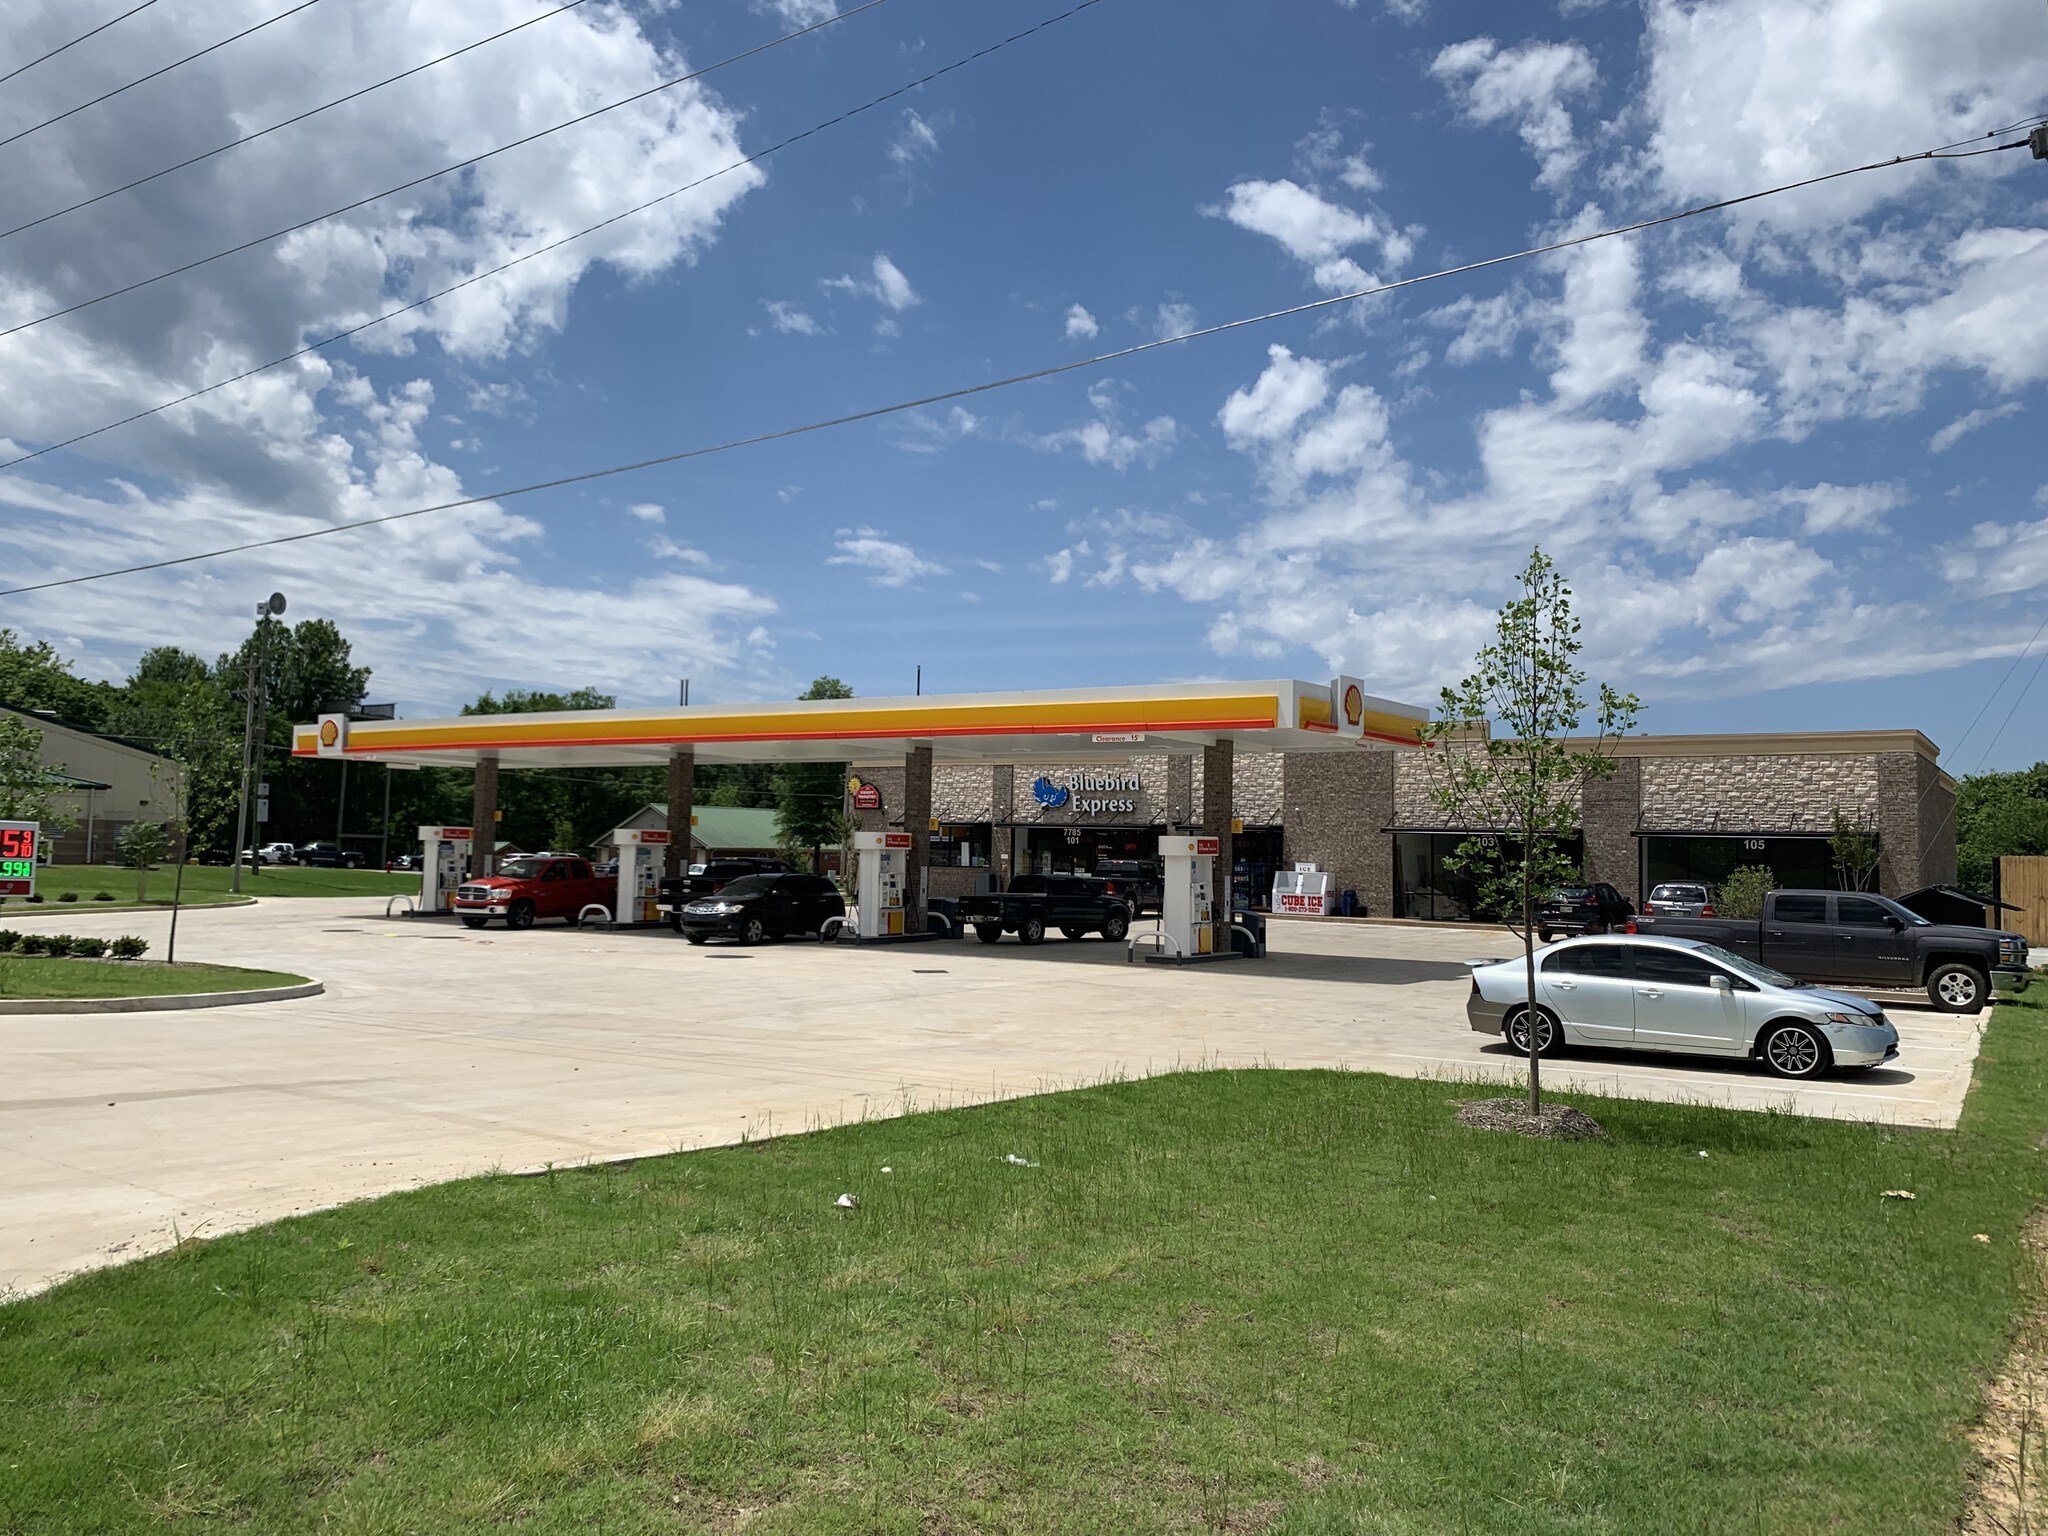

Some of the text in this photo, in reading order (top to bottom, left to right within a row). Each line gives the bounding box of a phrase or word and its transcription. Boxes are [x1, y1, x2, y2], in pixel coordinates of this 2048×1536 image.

[1069, 773, 1140, 791] Bluebird
[1072, 795, 1134, 817] Express
[1063, 829, 1081, 837] 7785
[1066, 836, 1079, 844] 101
[1476, 837, 1494, 846] 103
[1743, 839, 1765, 850] 105
[1281, 895, 1305, 906] CUBE
[1307, 896, 1323, 907] ICE
